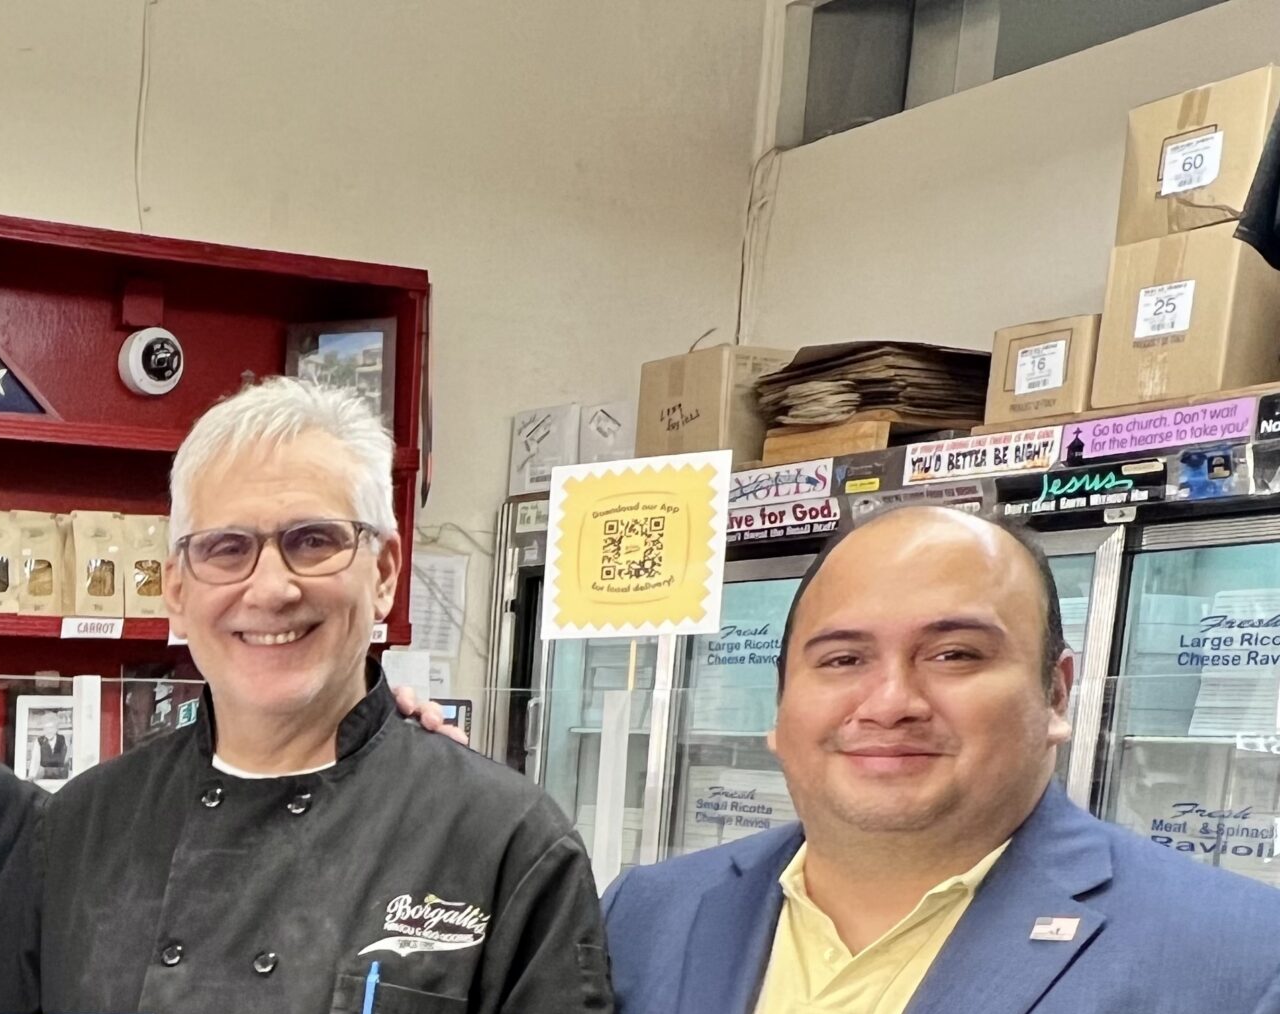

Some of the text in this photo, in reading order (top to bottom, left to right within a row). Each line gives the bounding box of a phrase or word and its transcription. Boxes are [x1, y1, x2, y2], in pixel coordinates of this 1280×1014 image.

[1182, 154, 1203, 172] 60
[1153, 298, 1176, 316] 25
[1031, 357, 1045, 371] 16
[1093, 404, 1237, 437] Go to church. Don't wait
[1091, 438, 1107, 452] for
[1108, 436, 1127, 449] the
[1131, 430, 1173, 447] hearse
[1175, 428, 1186, 440] to
[1190, 425, 1218, 439] take
[947, 449, 986, 471] BETTER
[994, 446, 1008, 465] BE
[1036, 471, 1133, 502] Jesus
[592, 502, 640, 518] Download
[660, 503, 679, 513] App
[760, 505, 786, 525] for
[792, 499, 838, 522] God.
[77, 623, 115, 634] CARROT
[721, 623, 771, 639] Fresh
[708, 640, 740, 653] Large
[1179, 633, 1234, 650] Large
[707, 654, 745, 665] Cheese
[1177, 651, 1240, 666] Cheese
[708, 786, 756, 800] Fresh
[696, 798, 773, 815] Small Ricotta
[1171, 802, 1253, 820] Fresh
[1151, 819, 1187, 834] Meat
[1200, 823, 1209, 835] &
[384, 894, 491, 934] Borgatti's
